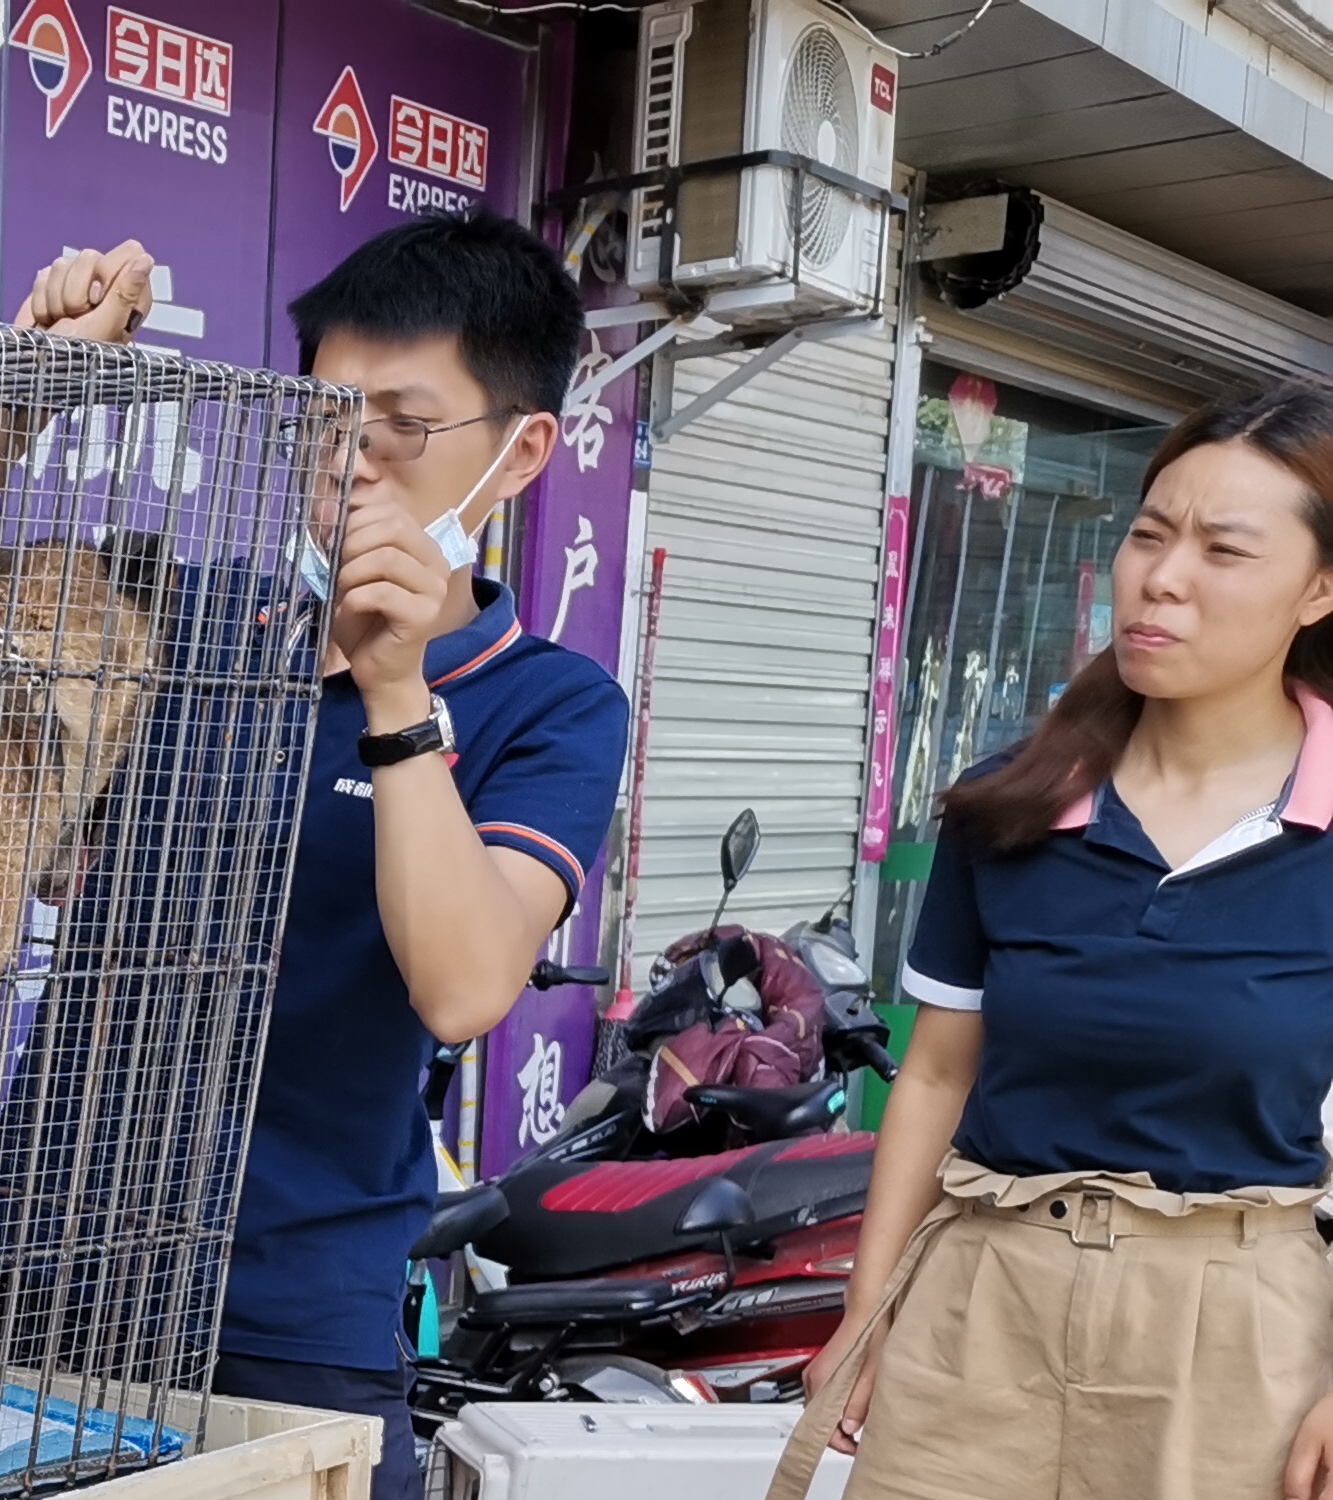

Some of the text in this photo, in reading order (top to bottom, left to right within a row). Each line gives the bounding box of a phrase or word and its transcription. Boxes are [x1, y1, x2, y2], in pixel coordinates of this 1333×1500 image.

[115, 17, 227, 110] 今日达
[874, 76, 892, 102] TCL
[107, 95, 228, 165] EXPRESS
[396, 105, 484, 185] 今日达
[388, 172, 479, 224] EXPRES
